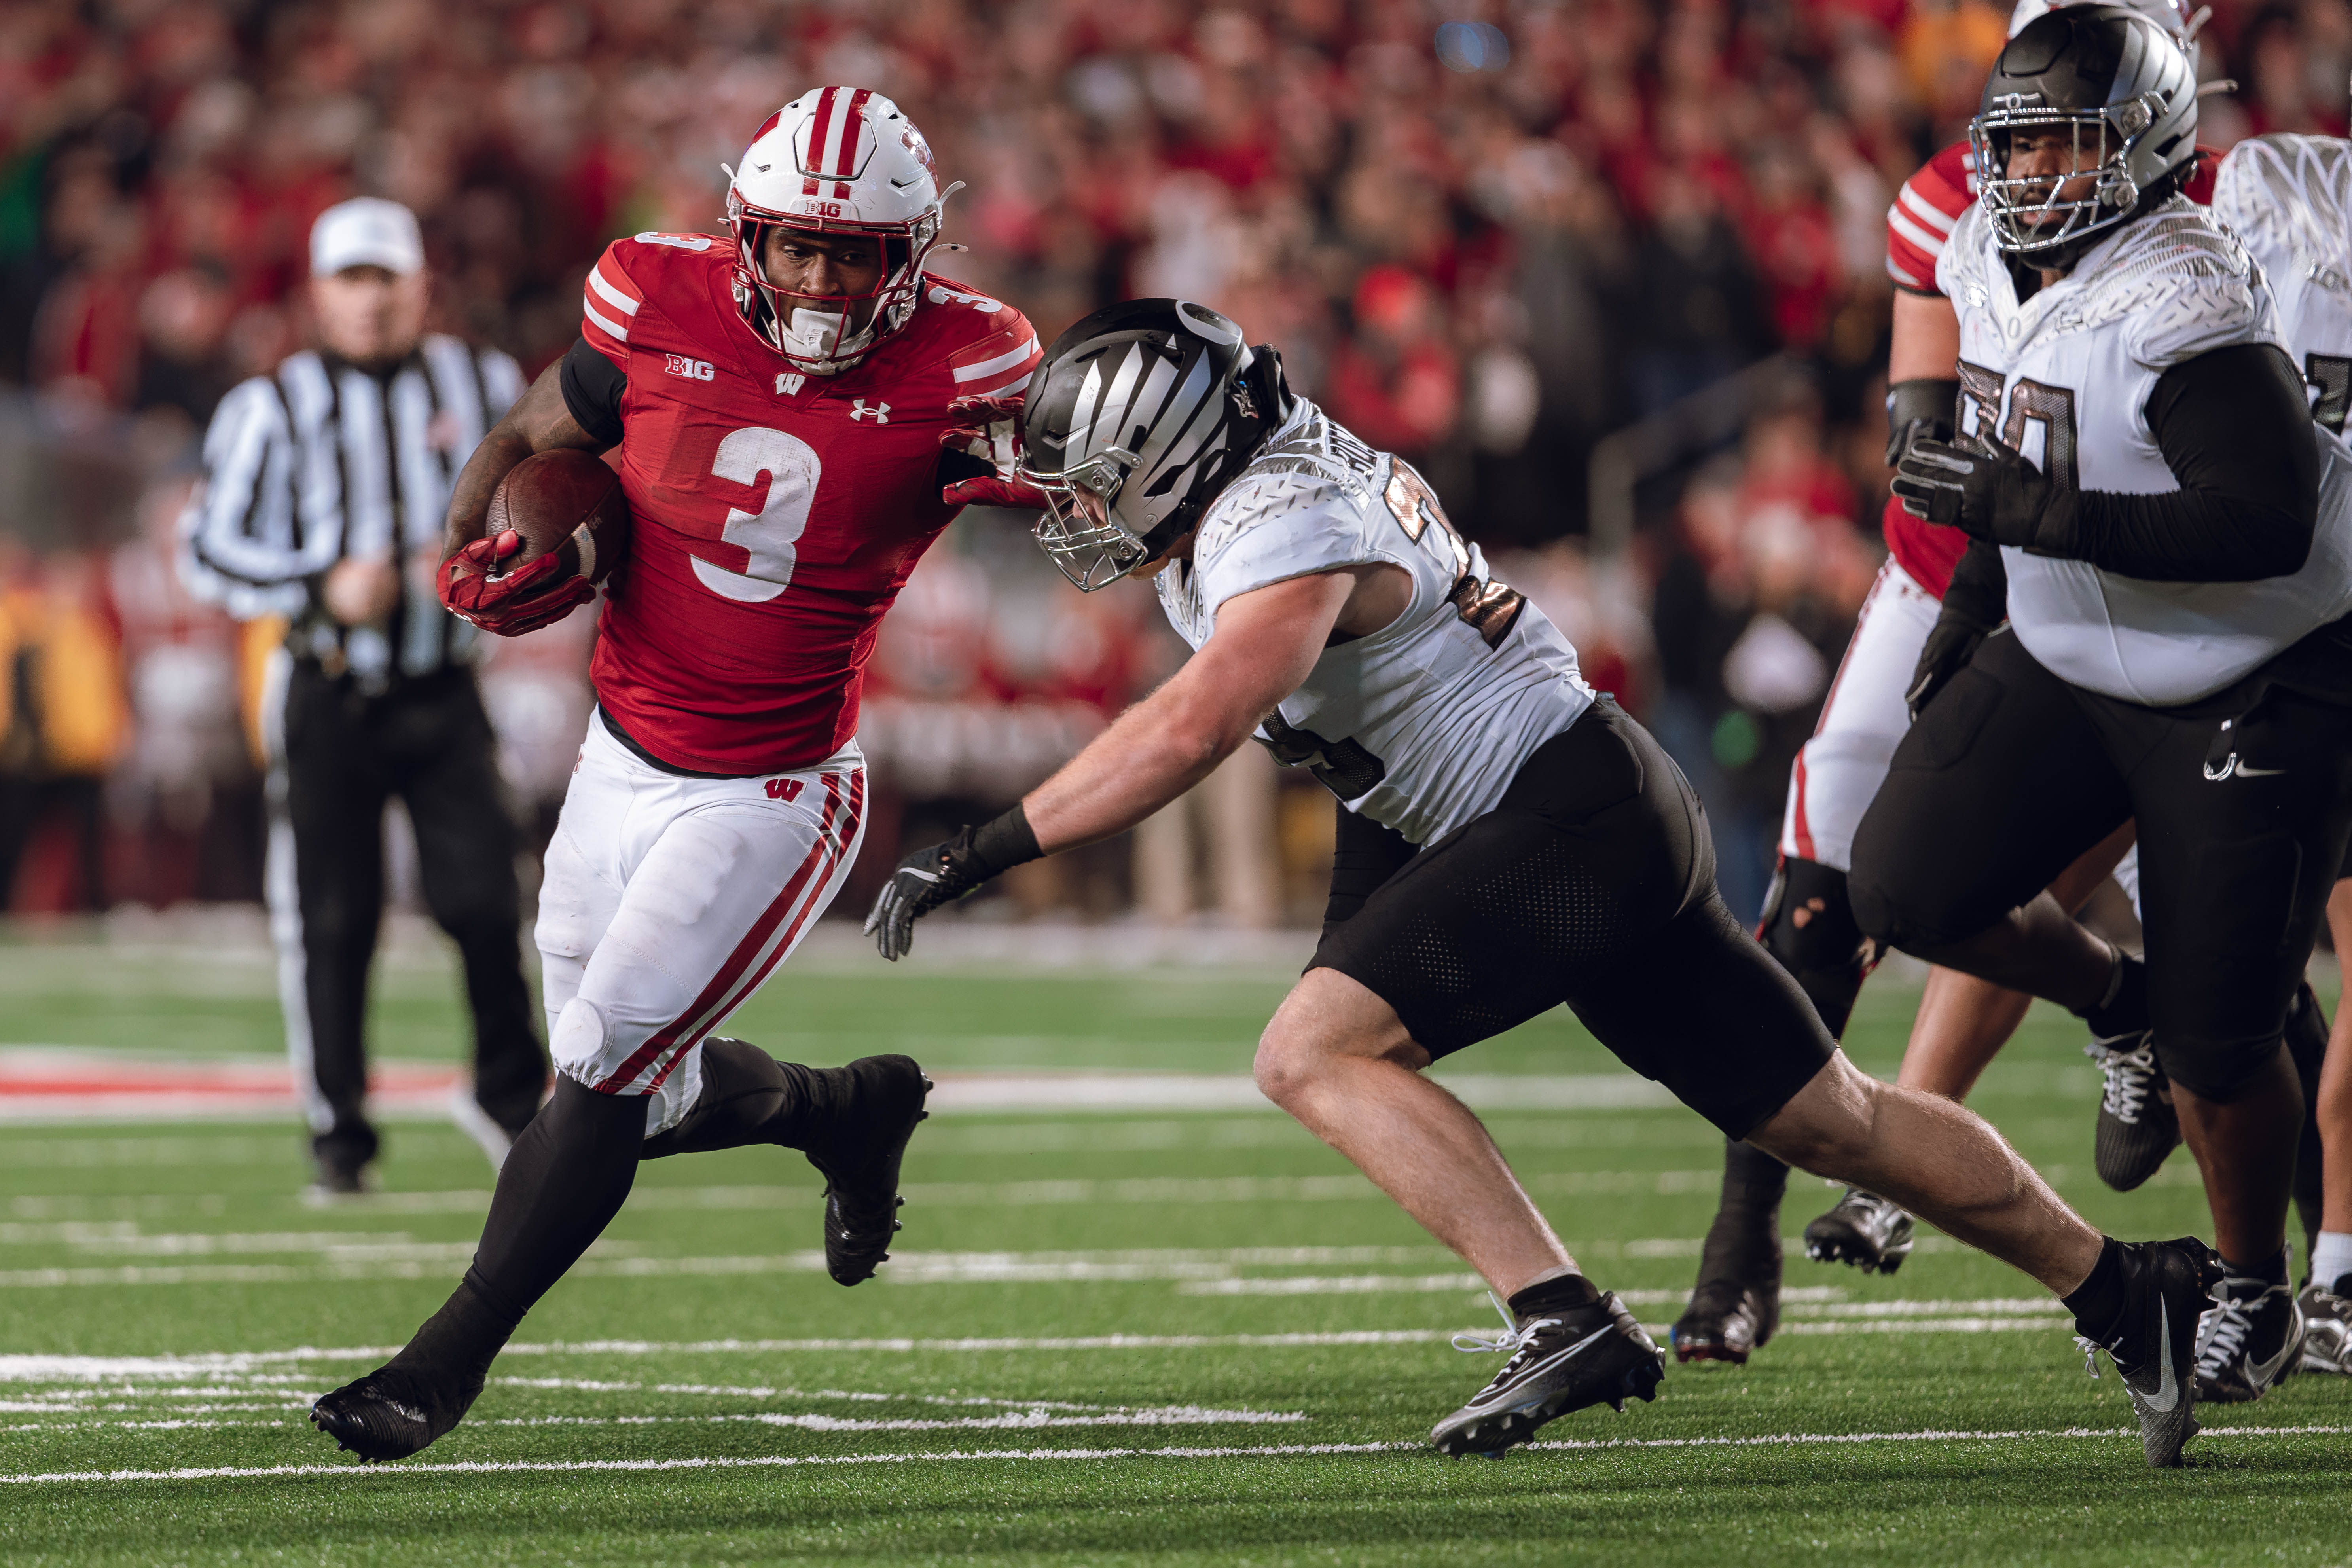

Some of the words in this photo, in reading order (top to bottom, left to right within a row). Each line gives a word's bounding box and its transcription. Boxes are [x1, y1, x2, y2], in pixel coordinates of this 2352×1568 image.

[928, 286, 1003, 313] 3
[774, 372, 806, 396] W
[689, 427, 822, 603] 3
[762, 777, 807, 805] W
